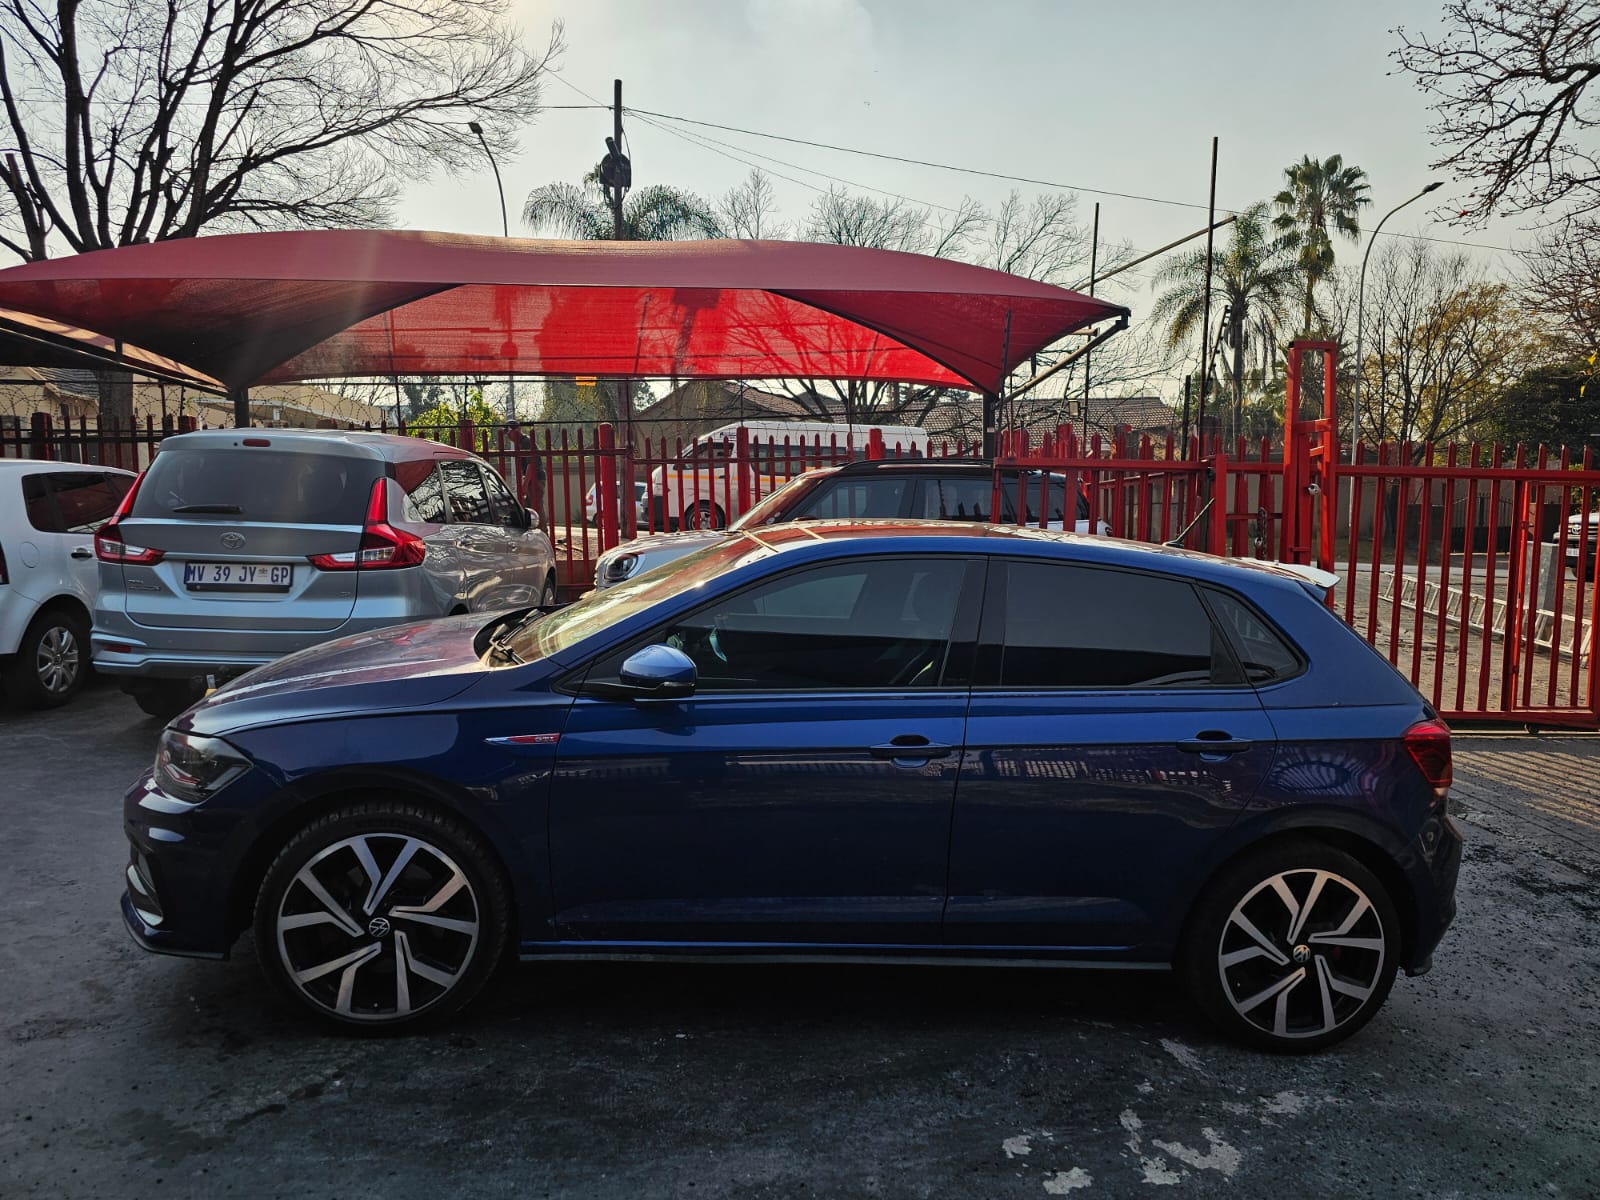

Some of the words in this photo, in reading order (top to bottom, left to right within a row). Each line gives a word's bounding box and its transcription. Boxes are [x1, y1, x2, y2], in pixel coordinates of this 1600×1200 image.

[187, 565, 206, 582] MV
[213, 566, 231, 582] 39
[239, 566, 257, 583] JY
[270, 566, 289, 583] GP
